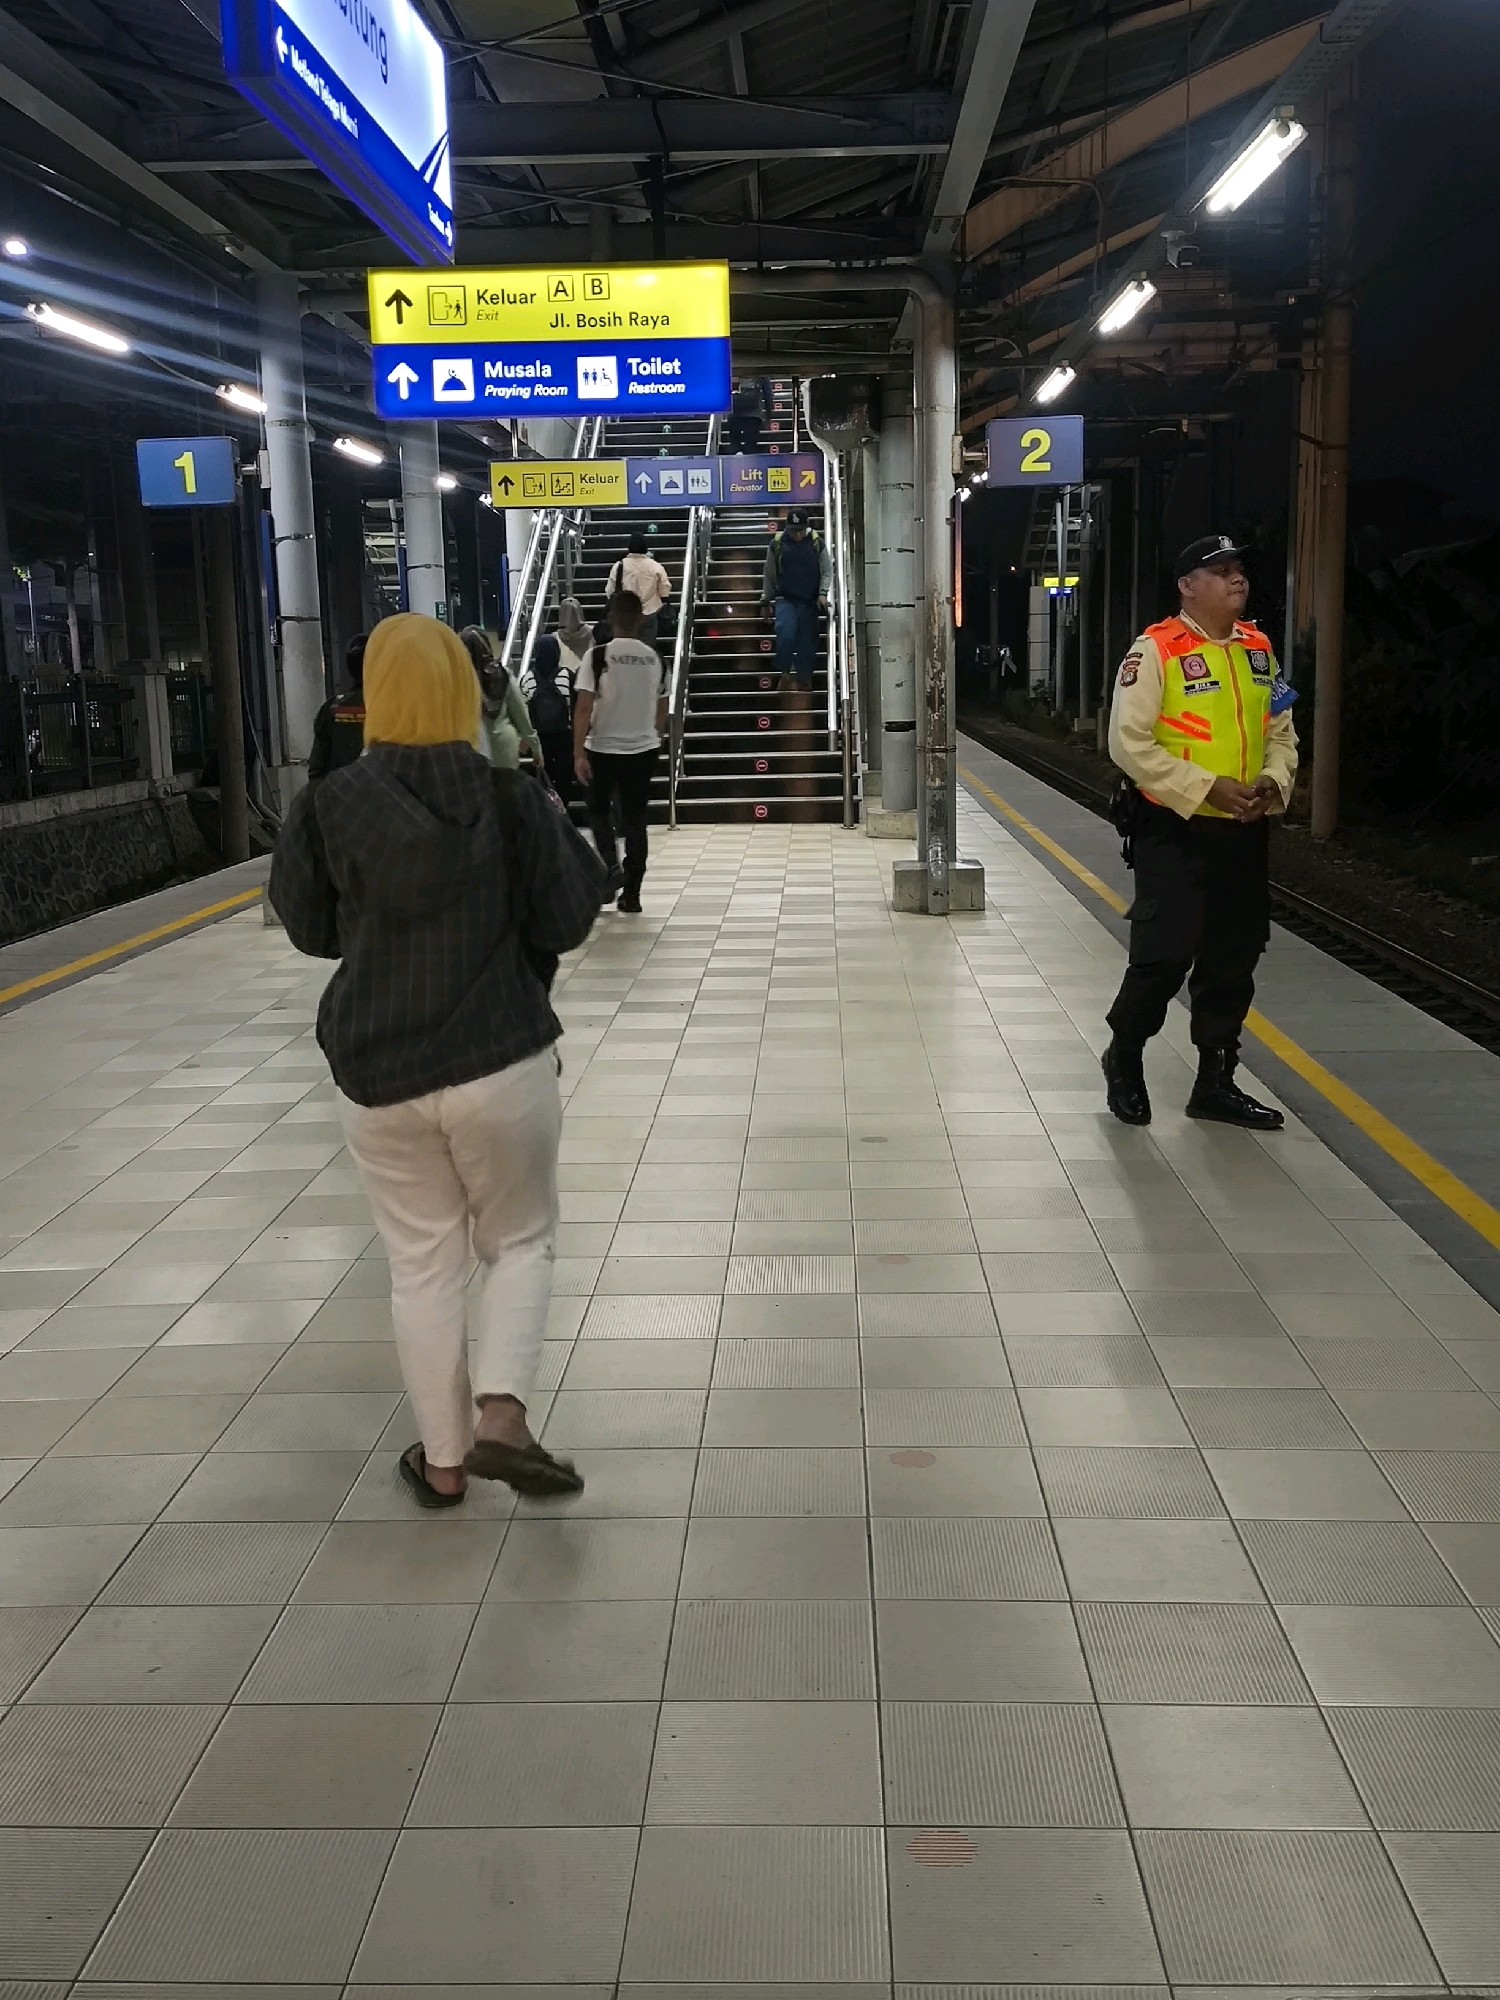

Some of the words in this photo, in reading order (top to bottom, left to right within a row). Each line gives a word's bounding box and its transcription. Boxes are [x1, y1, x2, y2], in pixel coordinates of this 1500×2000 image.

[552, 279, 569, 298] A
[590, 277, 604, 295] B
[476, 288, 537, 306] Keluar
[476, 308, 500, 322] Exit
[549, 313, 570, 329] Jl.
[576, 312, 623, 328] Bosih
[629, 312, 670, 330] Raya
[484, 360, 552, 378] Musala
[628, 357, 682, 375] Toilet
[484, 383, 532, 399] Praying
[533, 383, 569, 396] Room
[627, 382, 686, 395] Restroom
[1020, 428, 1051, 473] 2
[173, 451, 197, 494] 1
[579, 472, 620, 484] Keluar
[740, 469, 763, 482] Lift
[579, 487, 595, 495] Exit
[729, 483, 764, 493] Elevator
